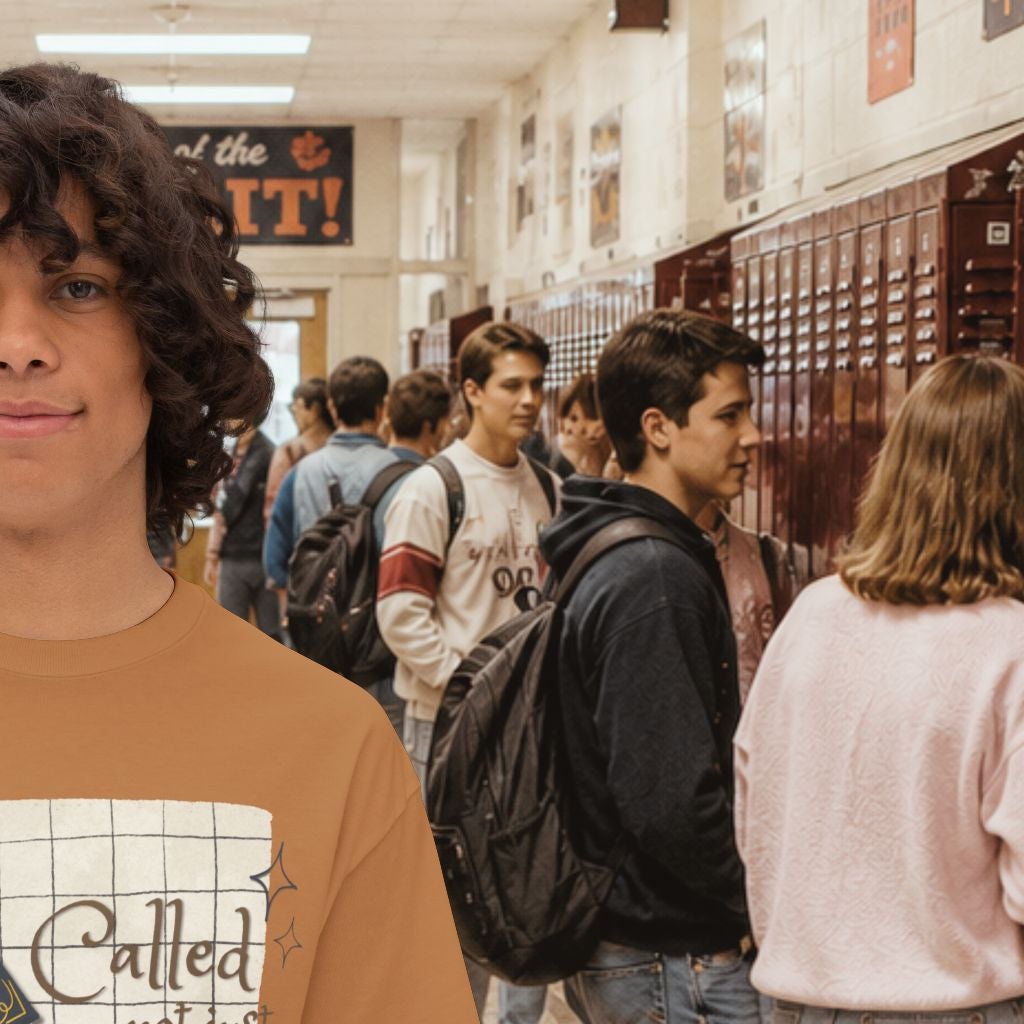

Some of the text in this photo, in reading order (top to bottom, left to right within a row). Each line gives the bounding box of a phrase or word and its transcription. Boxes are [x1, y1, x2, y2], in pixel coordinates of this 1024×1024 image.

[214, 131, 268, 166] the
[212, 177, 343, 237] IT!
[31, 898, 255, 1004] Called
